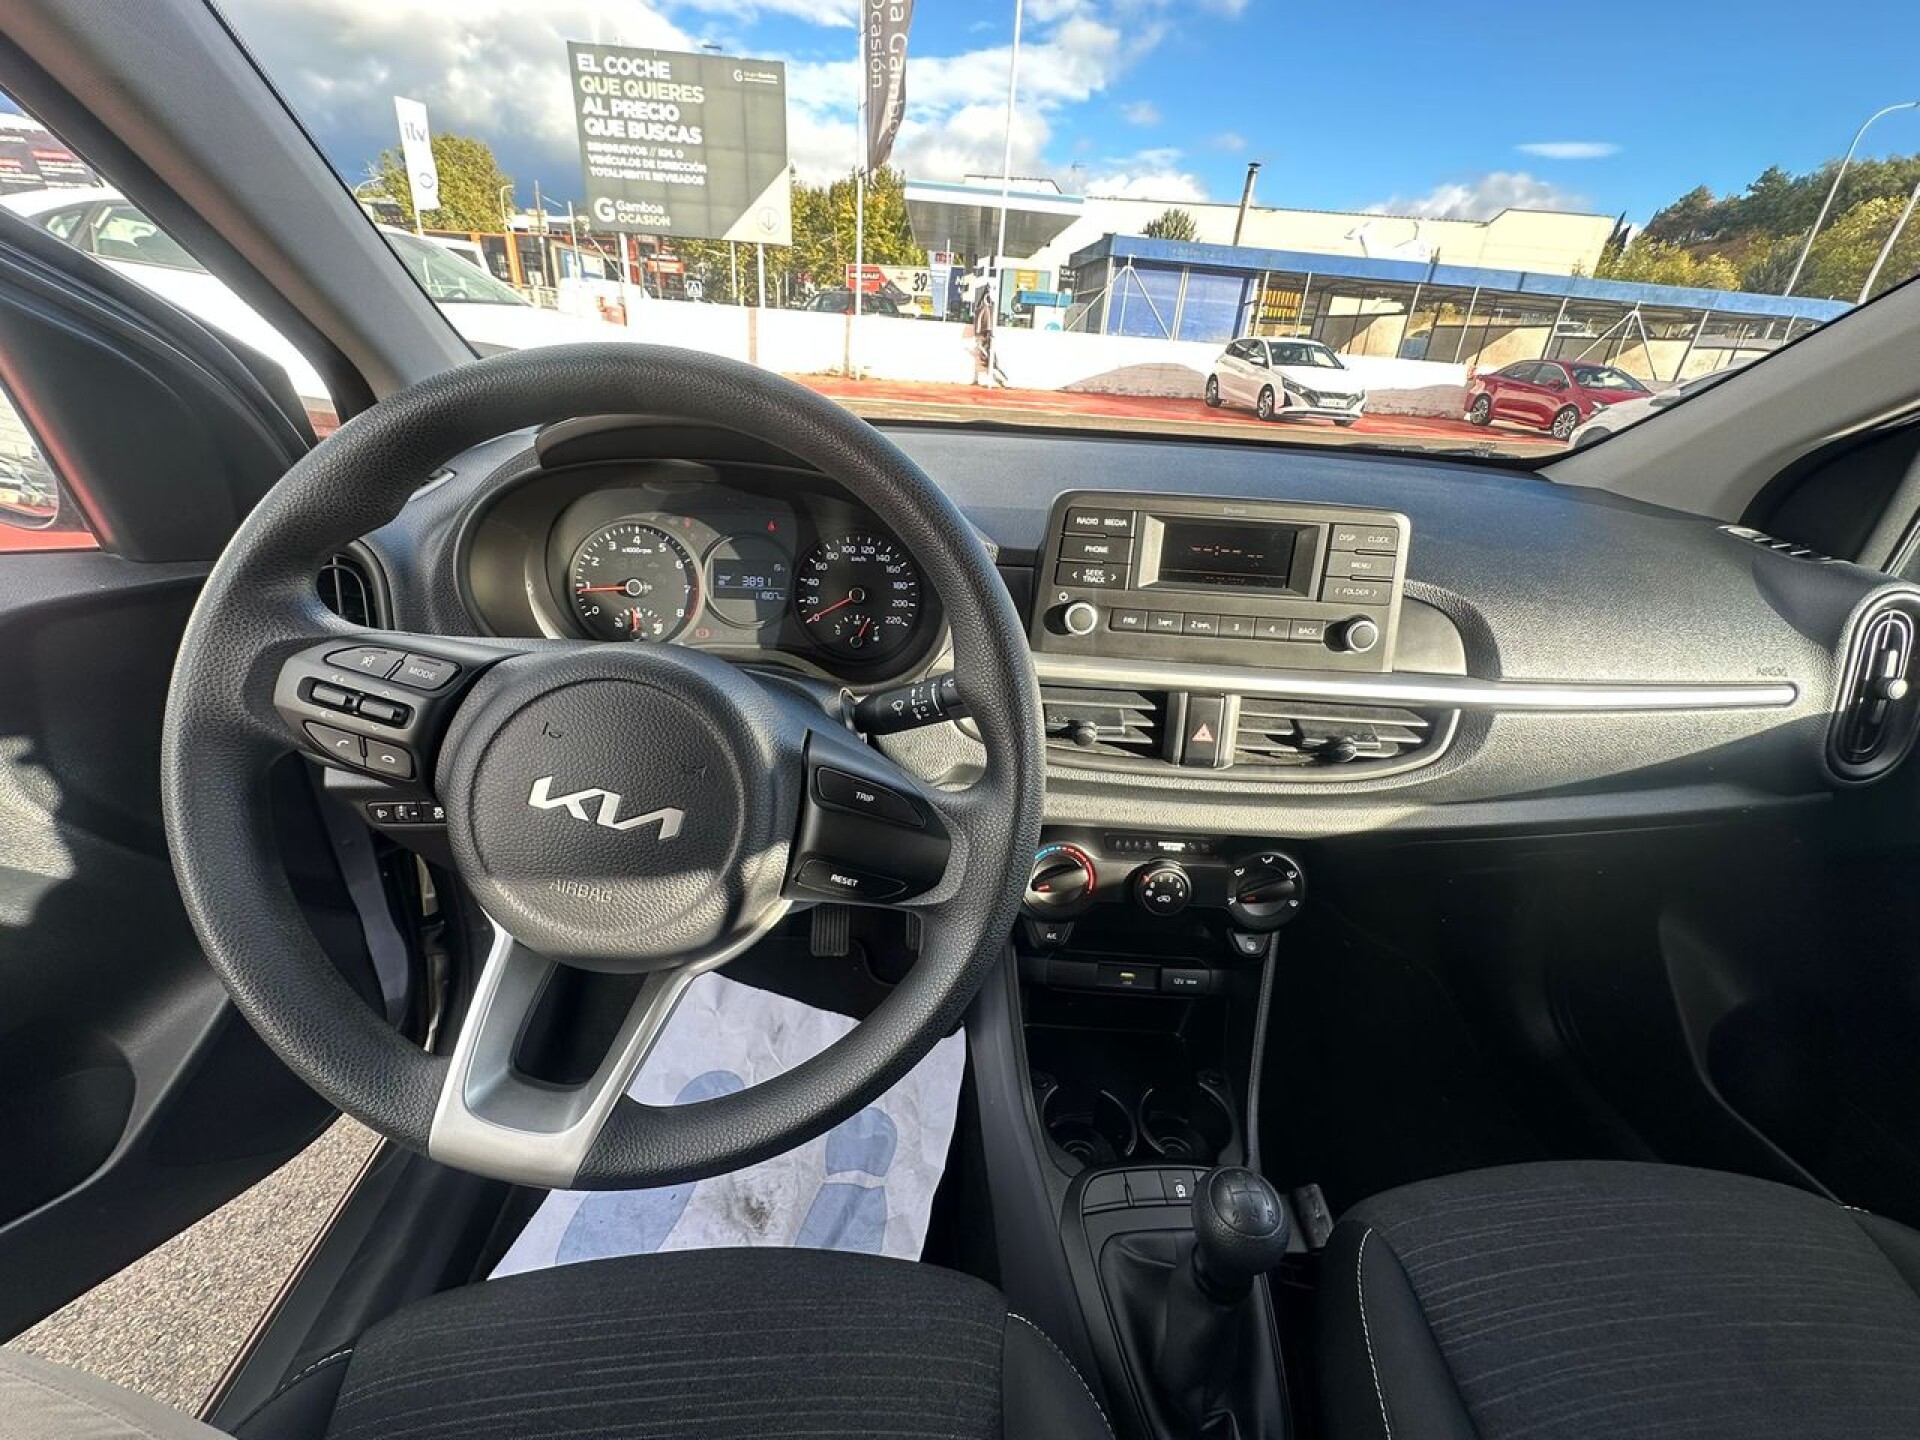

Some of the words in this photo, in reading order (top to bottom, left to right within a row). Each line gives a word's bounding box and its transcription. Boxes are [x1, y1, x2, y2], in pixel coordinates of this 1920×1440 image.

[576, 54, 601, 73] EL
[603, 57, 671, 80] COCHE
[580, 76, 621, 96] QUE
[624, 80, 704, 103] QUIERES
[582, 97, 609, 116] AL
[611, 98, 680, 122] PRECIO
[584, 118, 625, 138] QUE
[628, 122, 703, 144] BUSCAS
[594, 198, 615, 222] G
[616, 200, 664, 216] Gamboa
[912, 272, 928, 292] 39
[1076, 516, 1099, 526] RADIO
[1104, 518, 1127, 527] MEDIA
[633, 535, 641, 545] 4
[609, 541, 617, 551] 3
[658, 542, 667, 552] 5
[841, 546, 856, 554] 100
[861, 546, 876, 554] 120
[1084, 545, 1108, 553] PHONE
[826, 552, 839, 560] 80
[591, 557, 600, 566] 2
[675, 560, 683, 569] 6
[815, 562, 828, 571] 60
[886, 565, 901, 574] 160
[807, 578, 820, 586] 40
[893, 582, 908, 590] 180
[684, 585, 691, 595] 7
[806, 597, 819, 605] 20
[892, 600, 908, 608] 200
[592, 606, 600, 615] 0
[676, 608, 685, 618] 8
[885, 616, 902, 625] 220
[408, 666, 436, 681] MODE
[856, 791, 875, 802] TRIP
[830, 874, 859, 887] RESET
[549, 879, 613, 903] AIRBAG
